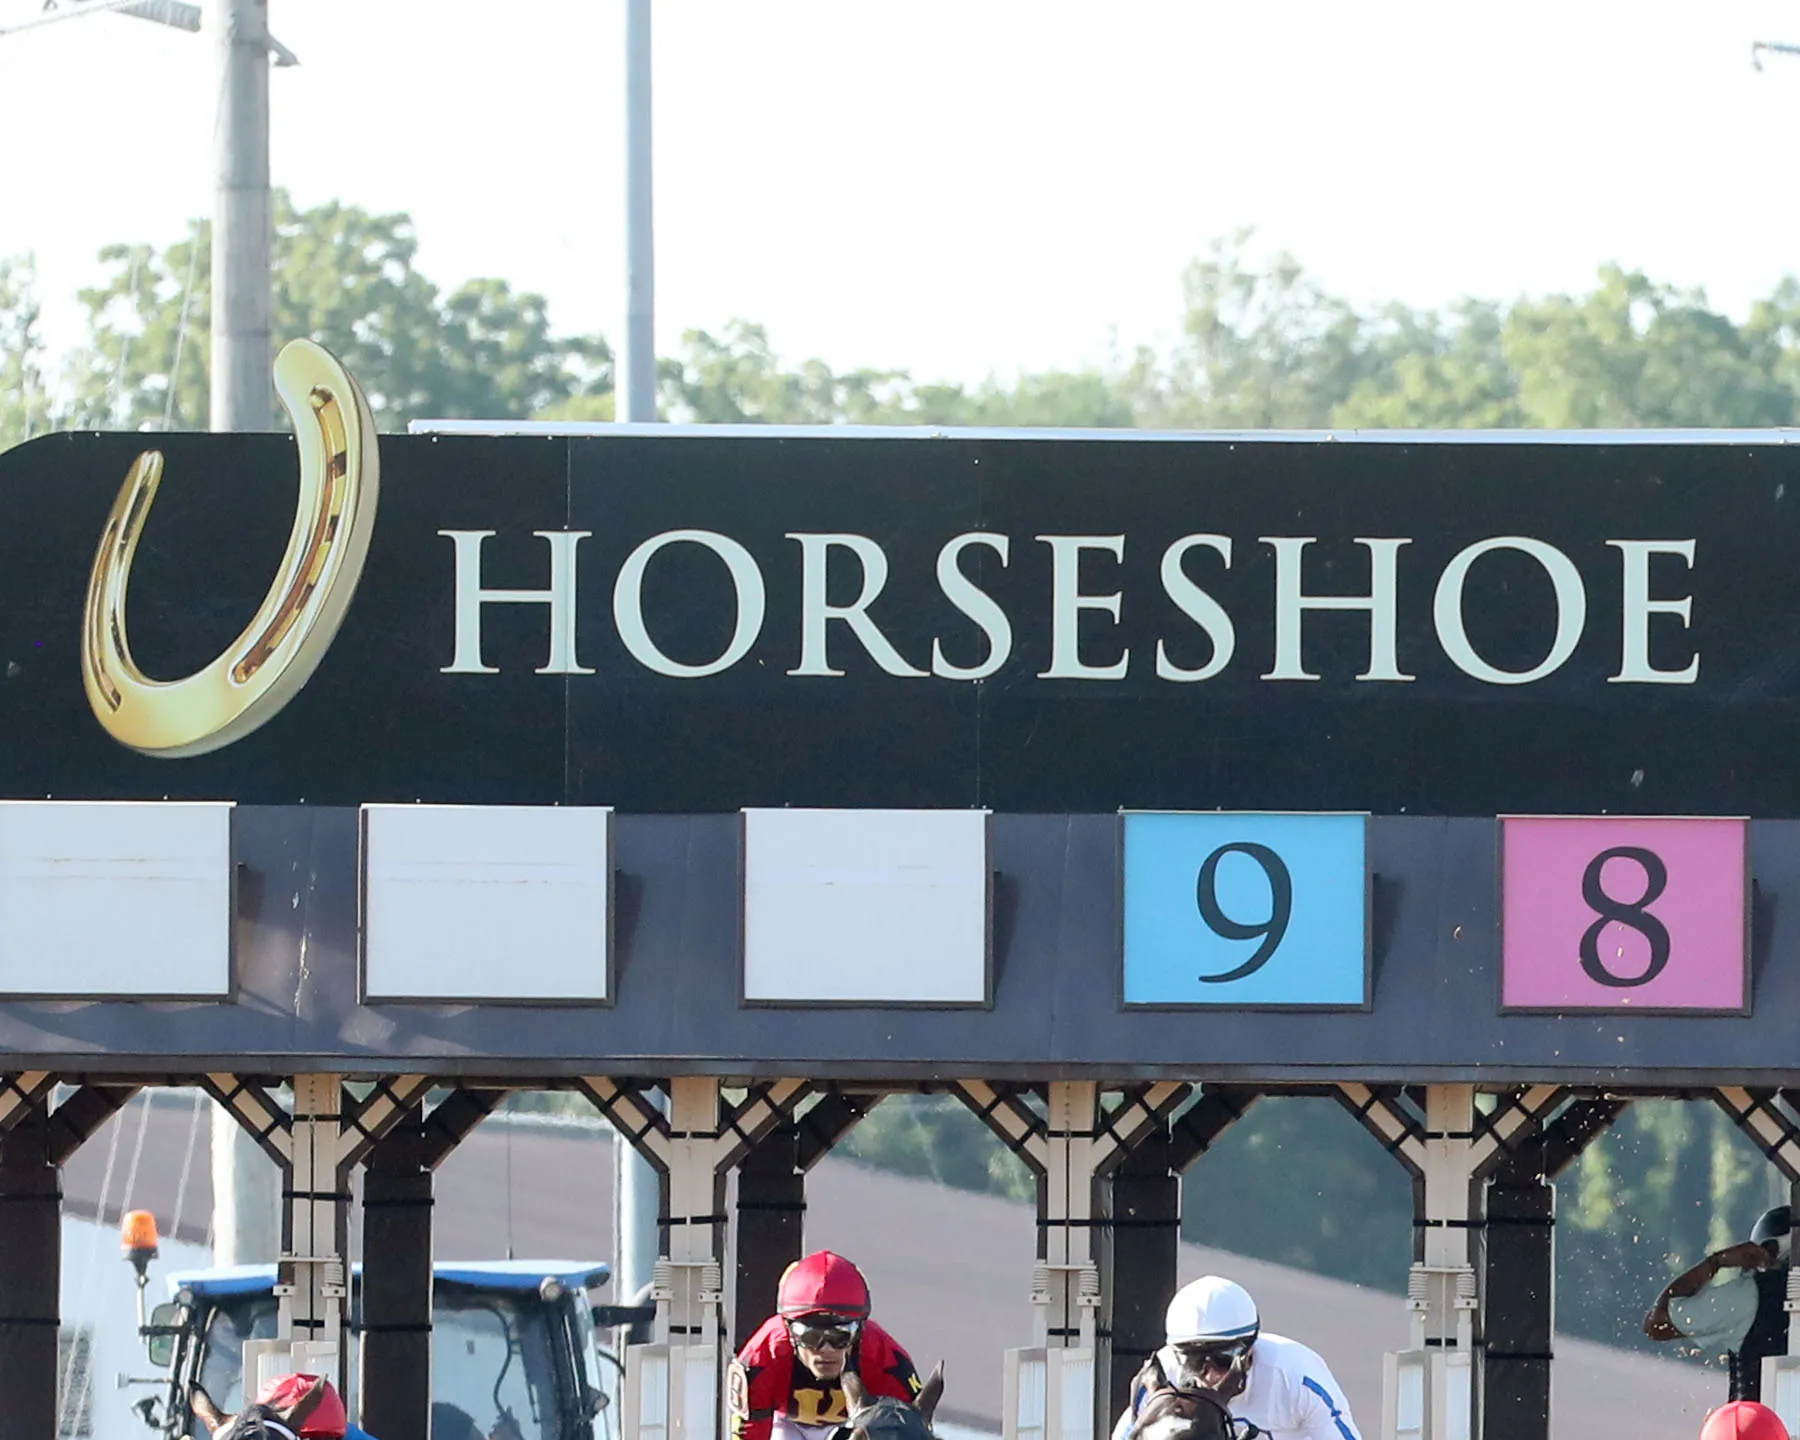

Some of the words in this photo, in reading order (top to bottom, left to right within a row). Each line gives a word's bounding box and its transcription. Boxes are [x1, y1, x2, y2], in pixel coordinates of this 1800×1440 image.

[438, 529, 1700, 684] HORSESHOE
[1196, 841, 1293, 984] 9
[1578, 845, 1671, 989] 8
